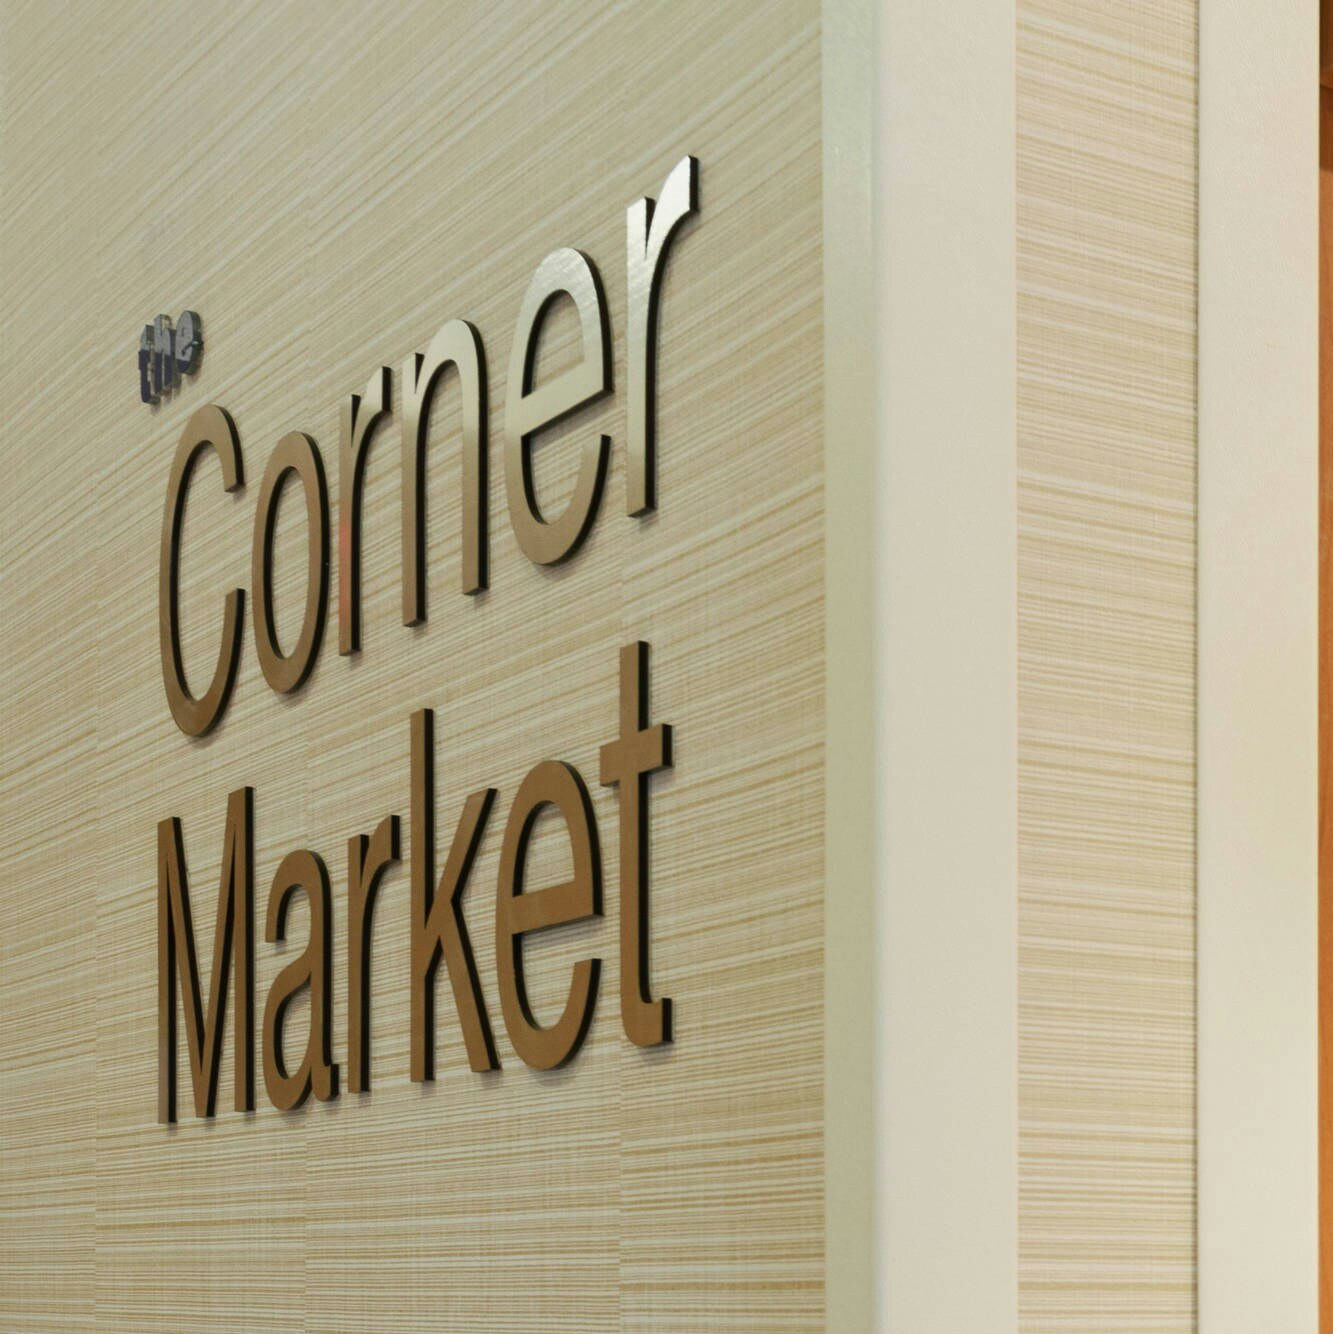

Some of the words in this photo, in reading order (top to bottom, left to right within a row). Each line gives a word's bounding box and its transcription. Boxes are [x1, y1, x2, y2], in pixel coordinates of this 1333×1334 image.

[138, 309, 204, 405] the
[159, 154, 699, 740] Corner
[157, 640, 673, 1124] Market
